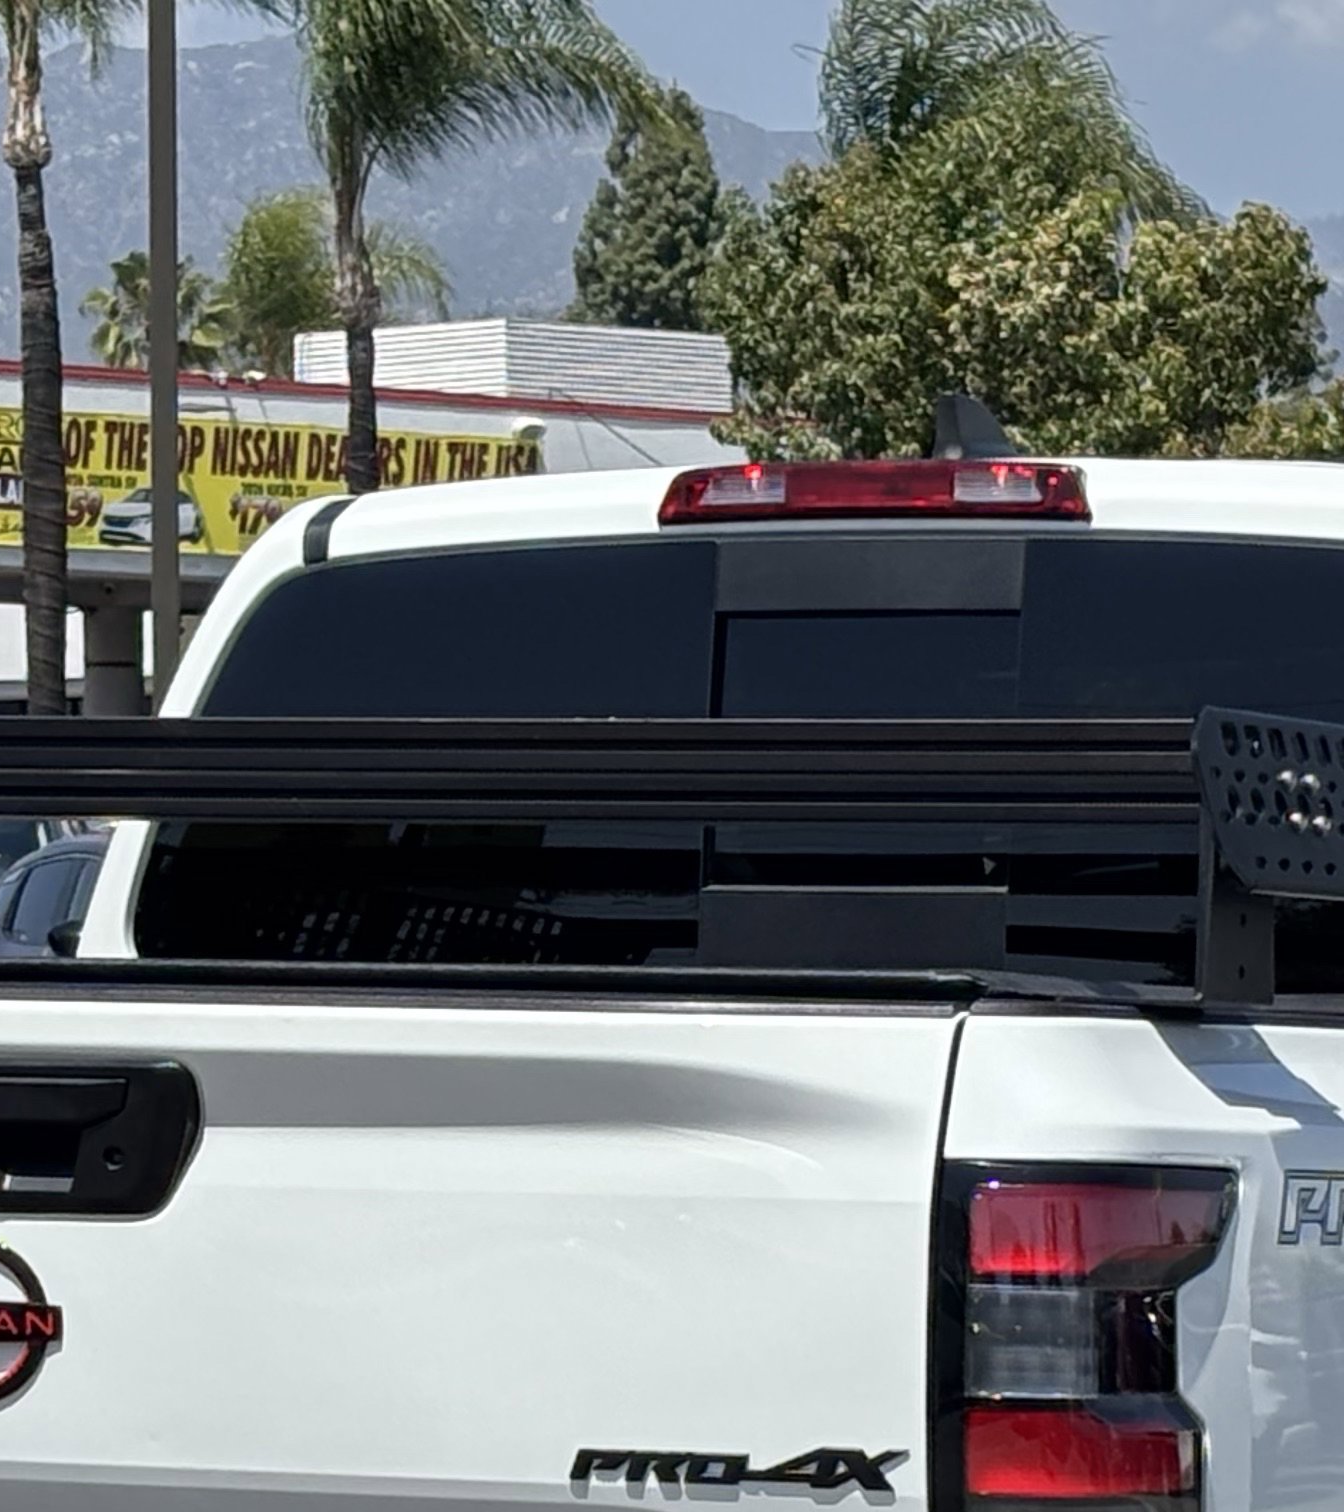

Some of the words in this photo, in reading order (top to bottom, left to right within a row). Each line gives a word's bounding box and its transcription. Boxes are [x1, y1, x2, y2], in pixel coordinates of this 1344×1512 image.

[66, 417, 97, 470] OF
[104, 419, 149, 471] THE
[176, 424, 205, 475] OP
[211, 426, 300, 479] NISSAN
[305, 433, 406, 487] DEARS
[413, 438, 440, 484] IN
[447, 441, 491, 481] THE
[66, 488, 104, 528] 59
